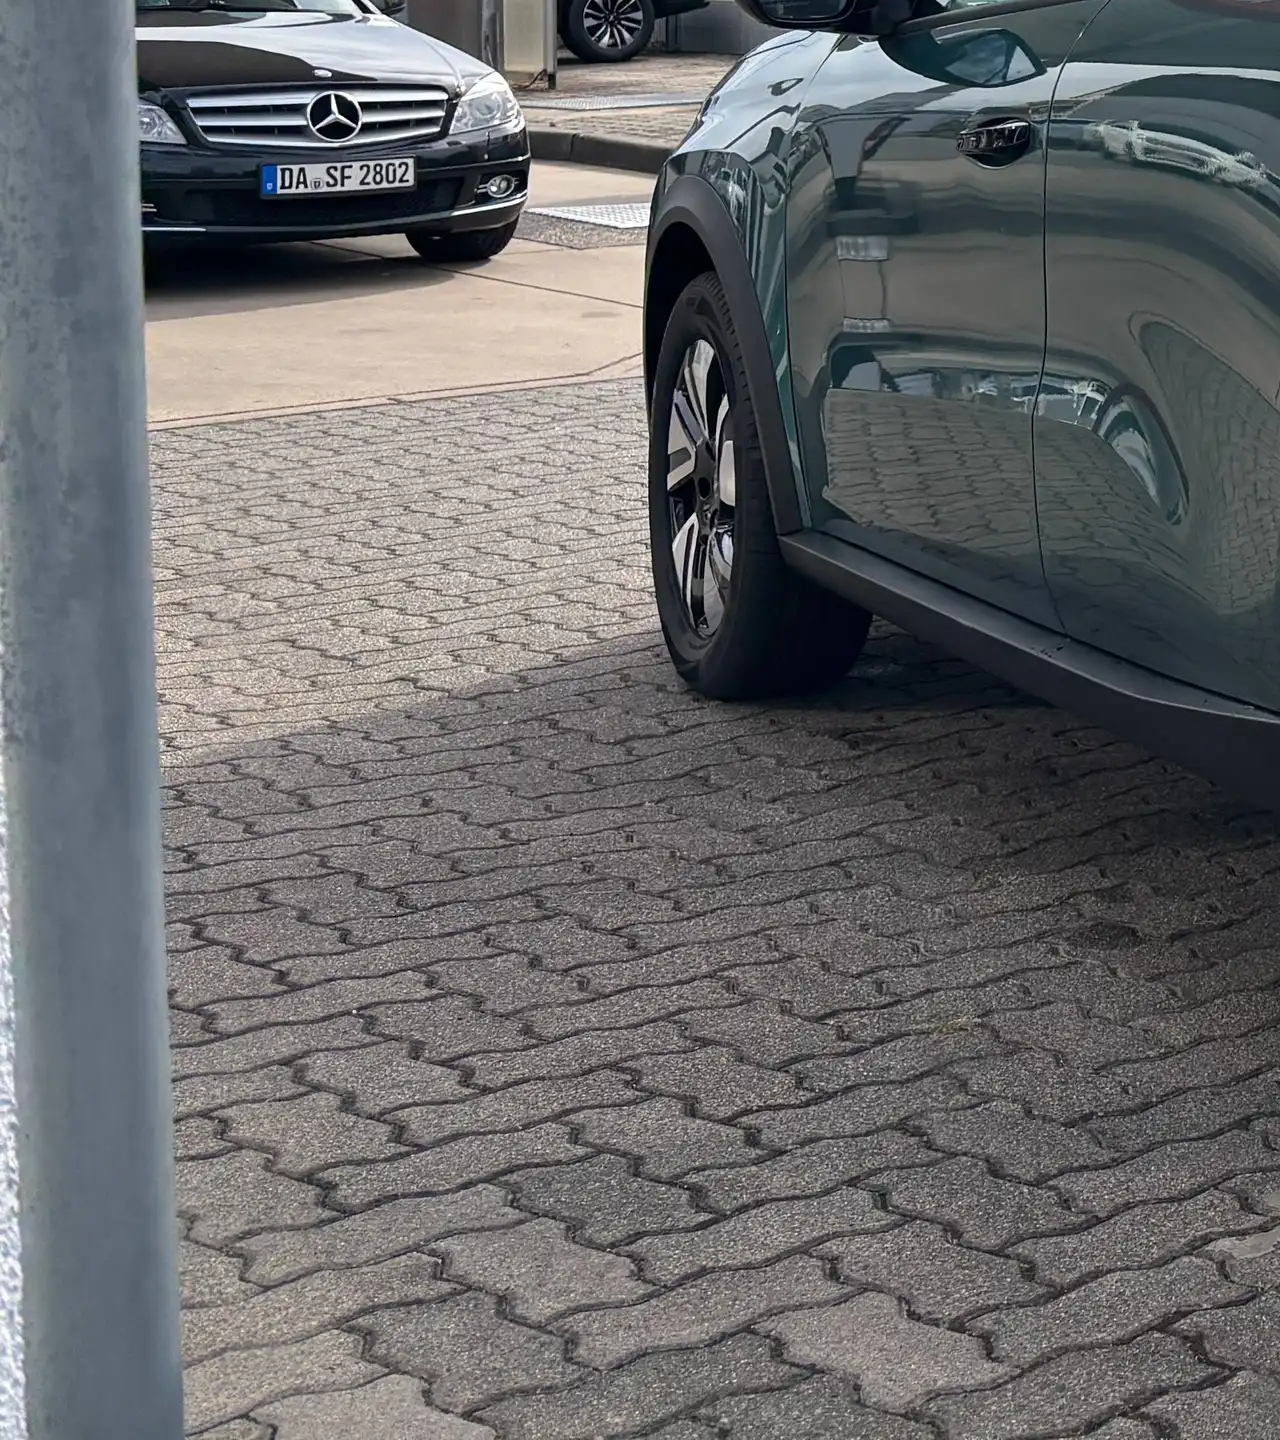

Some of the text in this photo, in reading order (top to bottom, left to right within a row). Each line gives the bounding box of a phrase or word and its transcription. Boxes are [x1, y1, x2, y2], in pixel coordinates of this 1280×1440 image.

[279, 161, 410, 190] DA SF 2802
